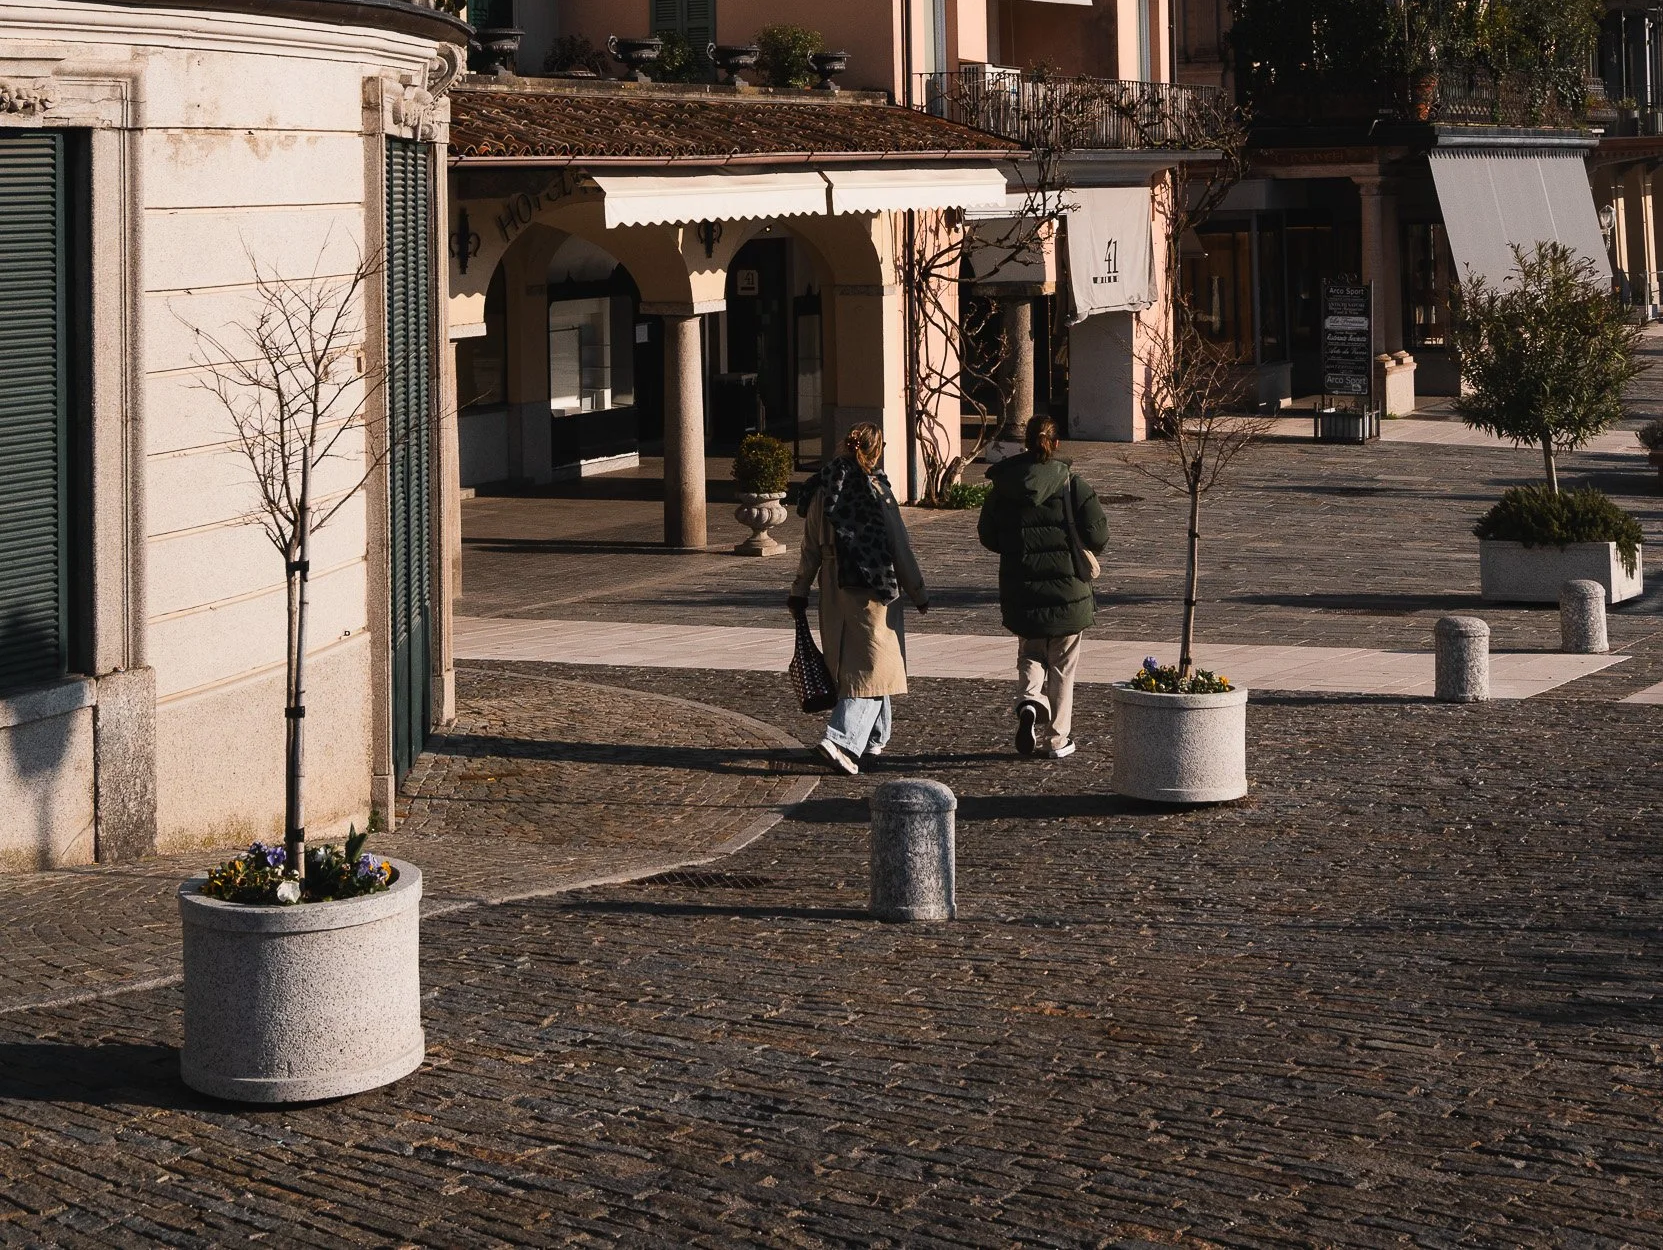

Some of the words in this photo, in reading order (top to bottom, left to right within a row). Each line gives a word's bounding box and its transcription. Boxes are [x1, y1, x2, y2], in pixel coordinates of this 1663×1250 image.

[1104, 238, 1118, 273] 41
[1329, 287, 1344, 295] Arco
[1346, 288, 1364, 296] Sport
[1326, 375, 1344, 384] Arco
[1345, 376, 1367, 385] Sport
